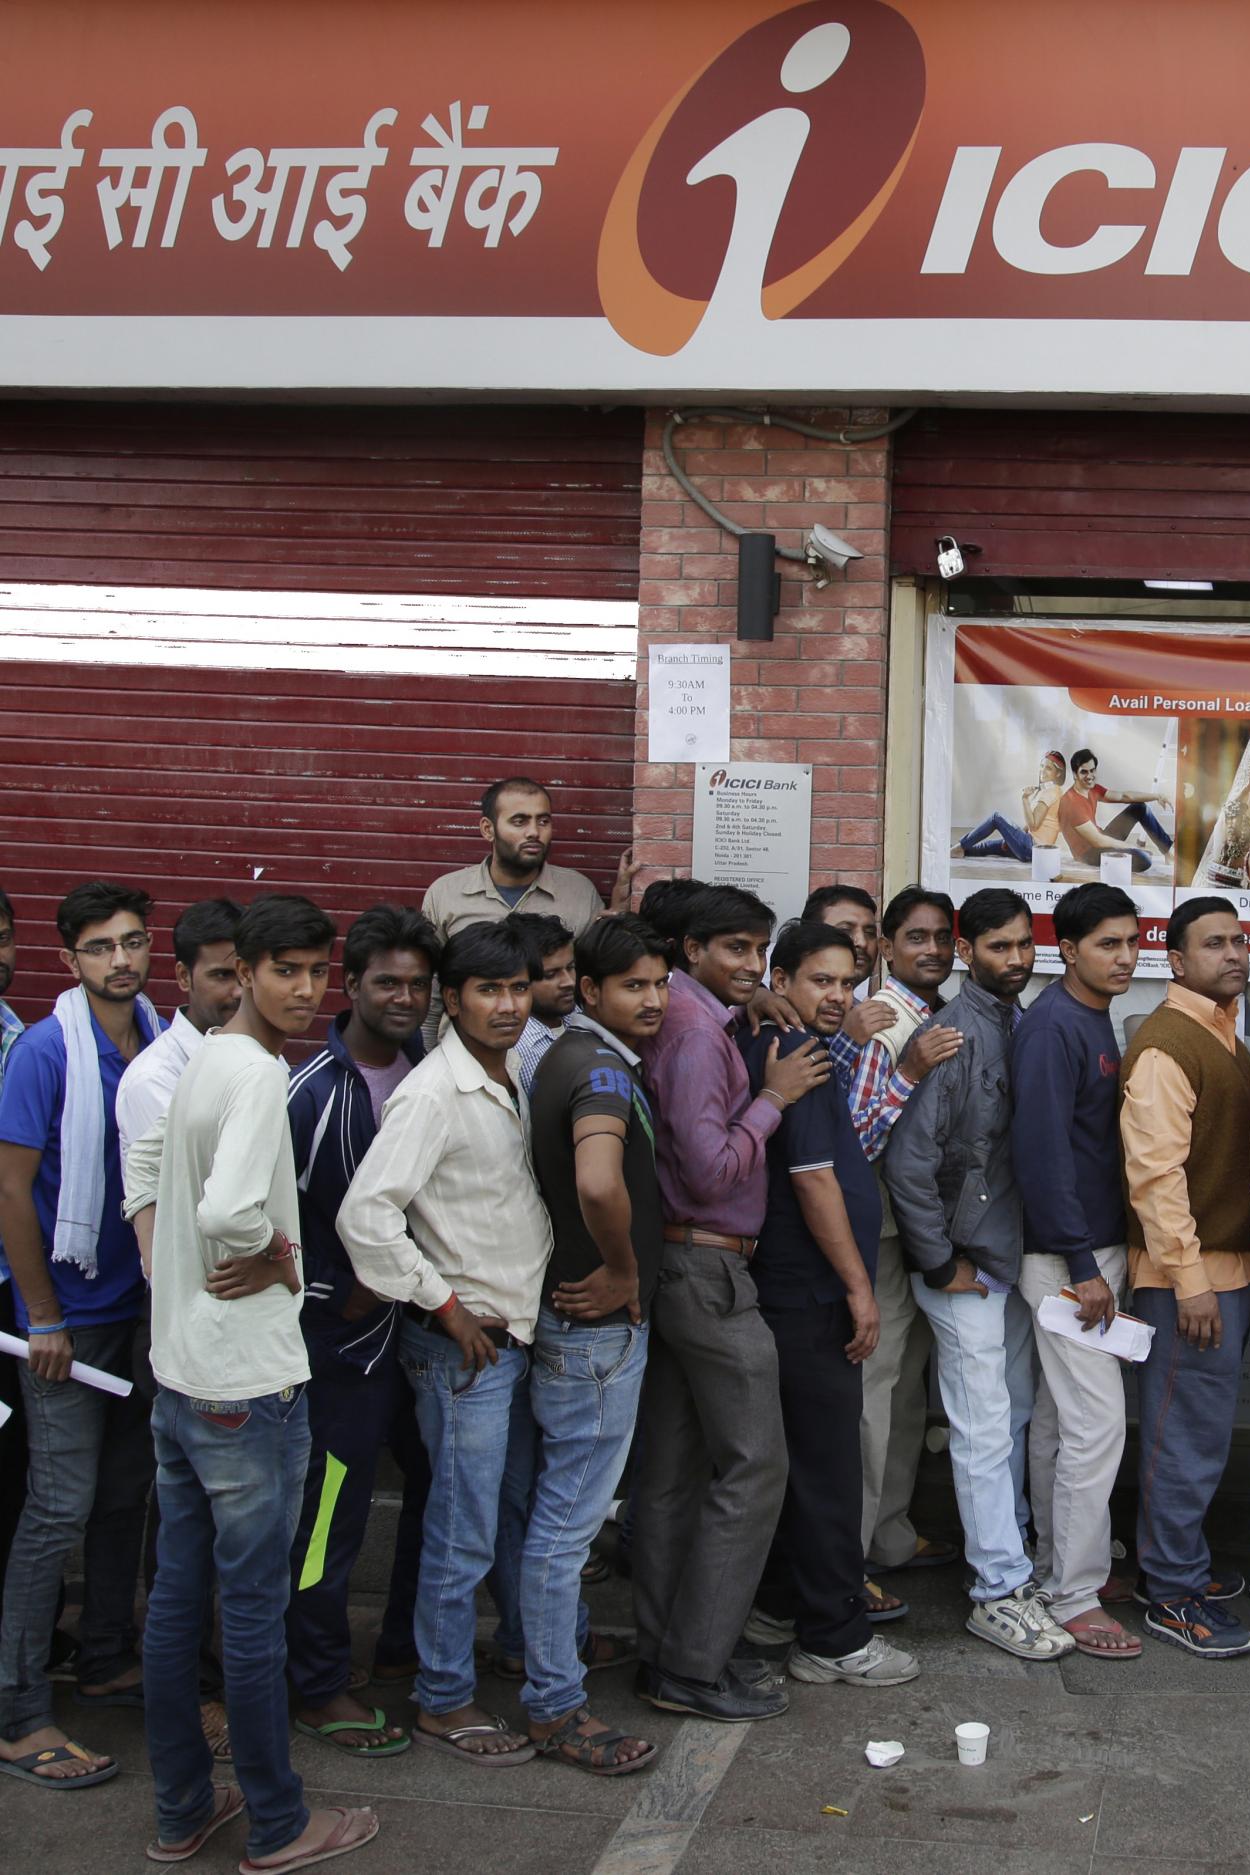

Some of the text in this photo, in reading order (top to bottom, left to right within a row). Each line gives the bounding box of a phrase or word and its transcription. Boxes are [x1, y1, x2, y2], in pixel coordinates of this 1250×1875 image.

[0, 101, 559, 272] ई सी आई बैंक
[657, 654, 724, 665] Branch Timing
[681, 693, 693, 702] To
[1109, 695, 1148, 709] Avail
[1153, 696, 1220, 711] Personal
[690, 706, 706, 715] PM
[724, 778, 798, 791] ICICI Bank
